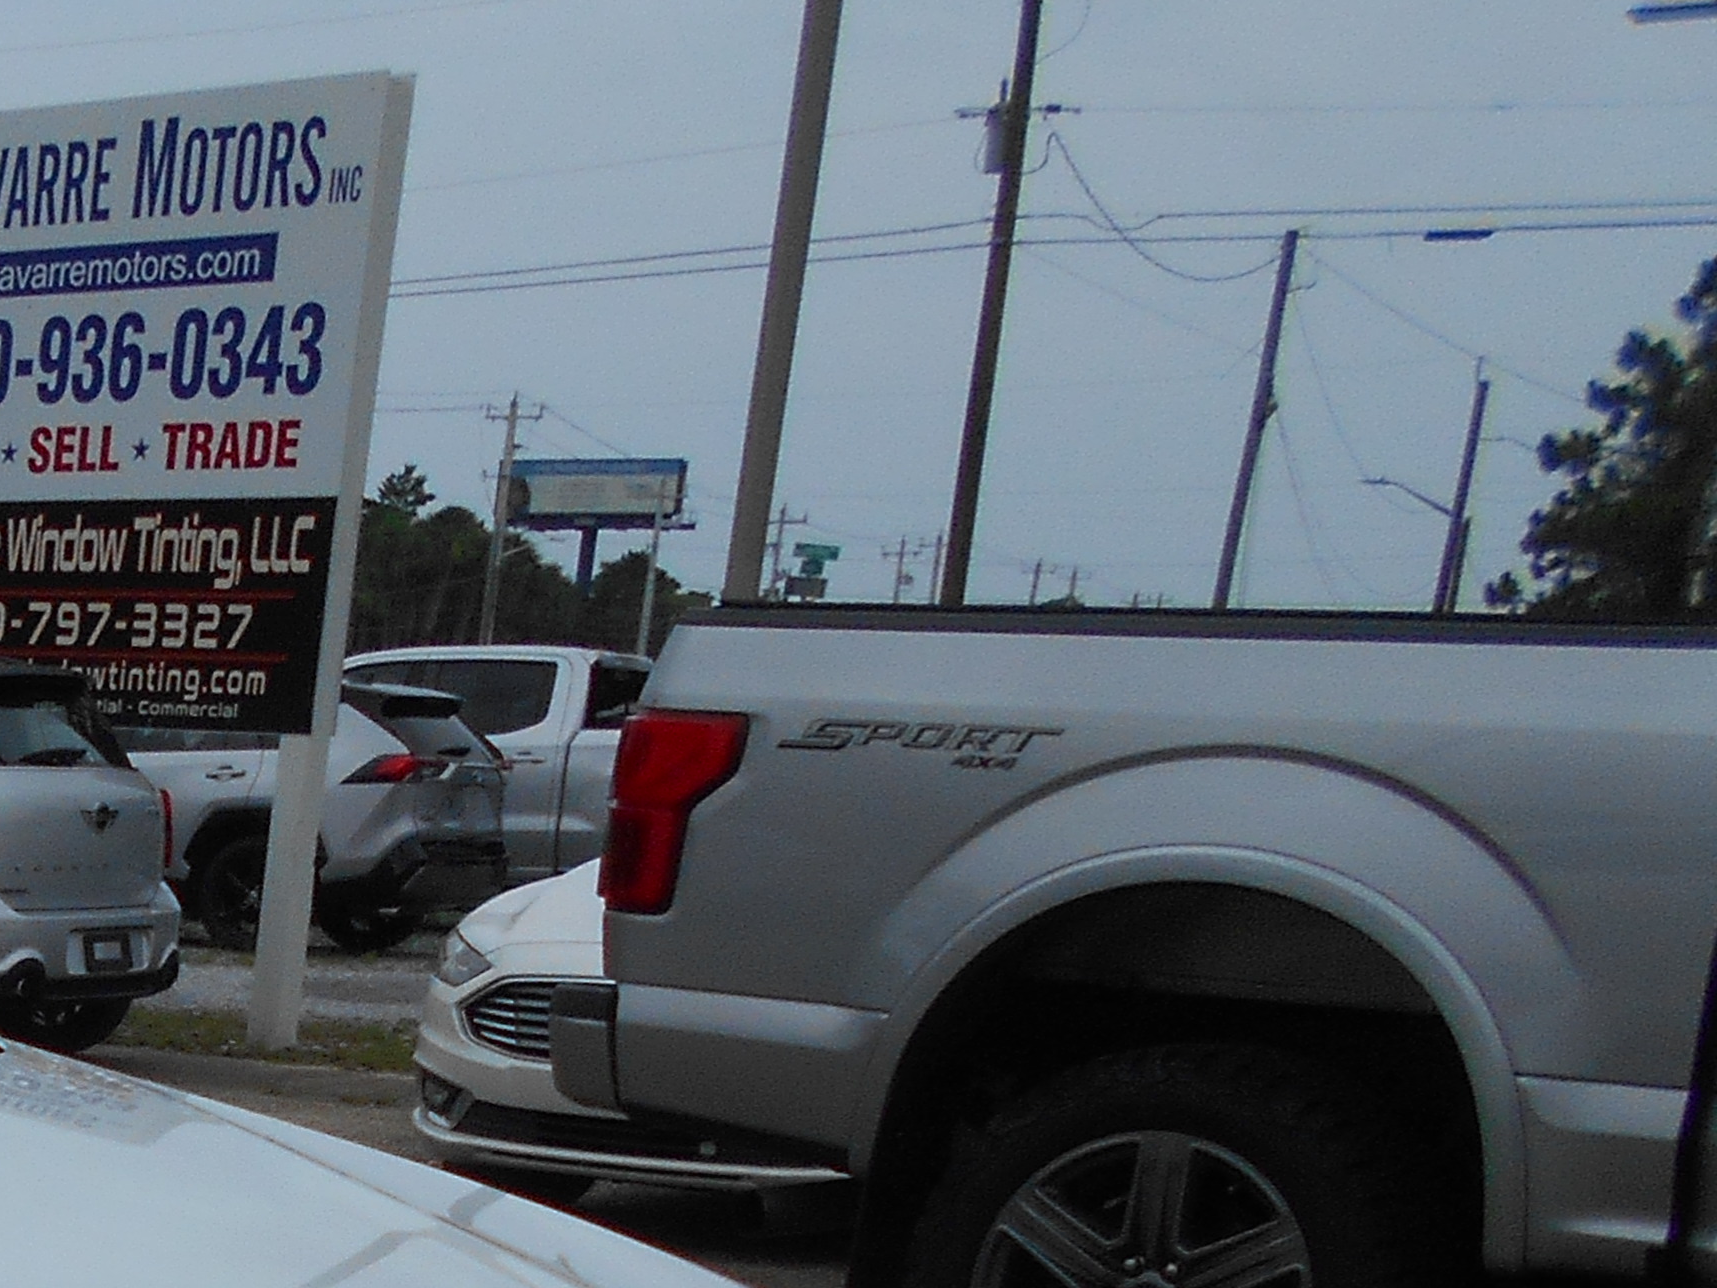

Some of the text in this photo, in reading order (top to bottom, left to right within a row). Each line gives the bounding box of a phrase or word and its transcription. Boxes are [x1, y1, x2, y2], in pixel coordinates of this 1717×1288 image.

[131, 115, 327, 219] MOTORS
[328, 164, 364, 205] INC
[27, 425, 120, 475] SELL
[162, 419, 303, 471] TRADE
[7, 515, 130, 574] Window
[250, 515, 316, 575] LLC
[137, 700, 239, 719] Commercial
[776, 717, 1065, 752] SPORT
